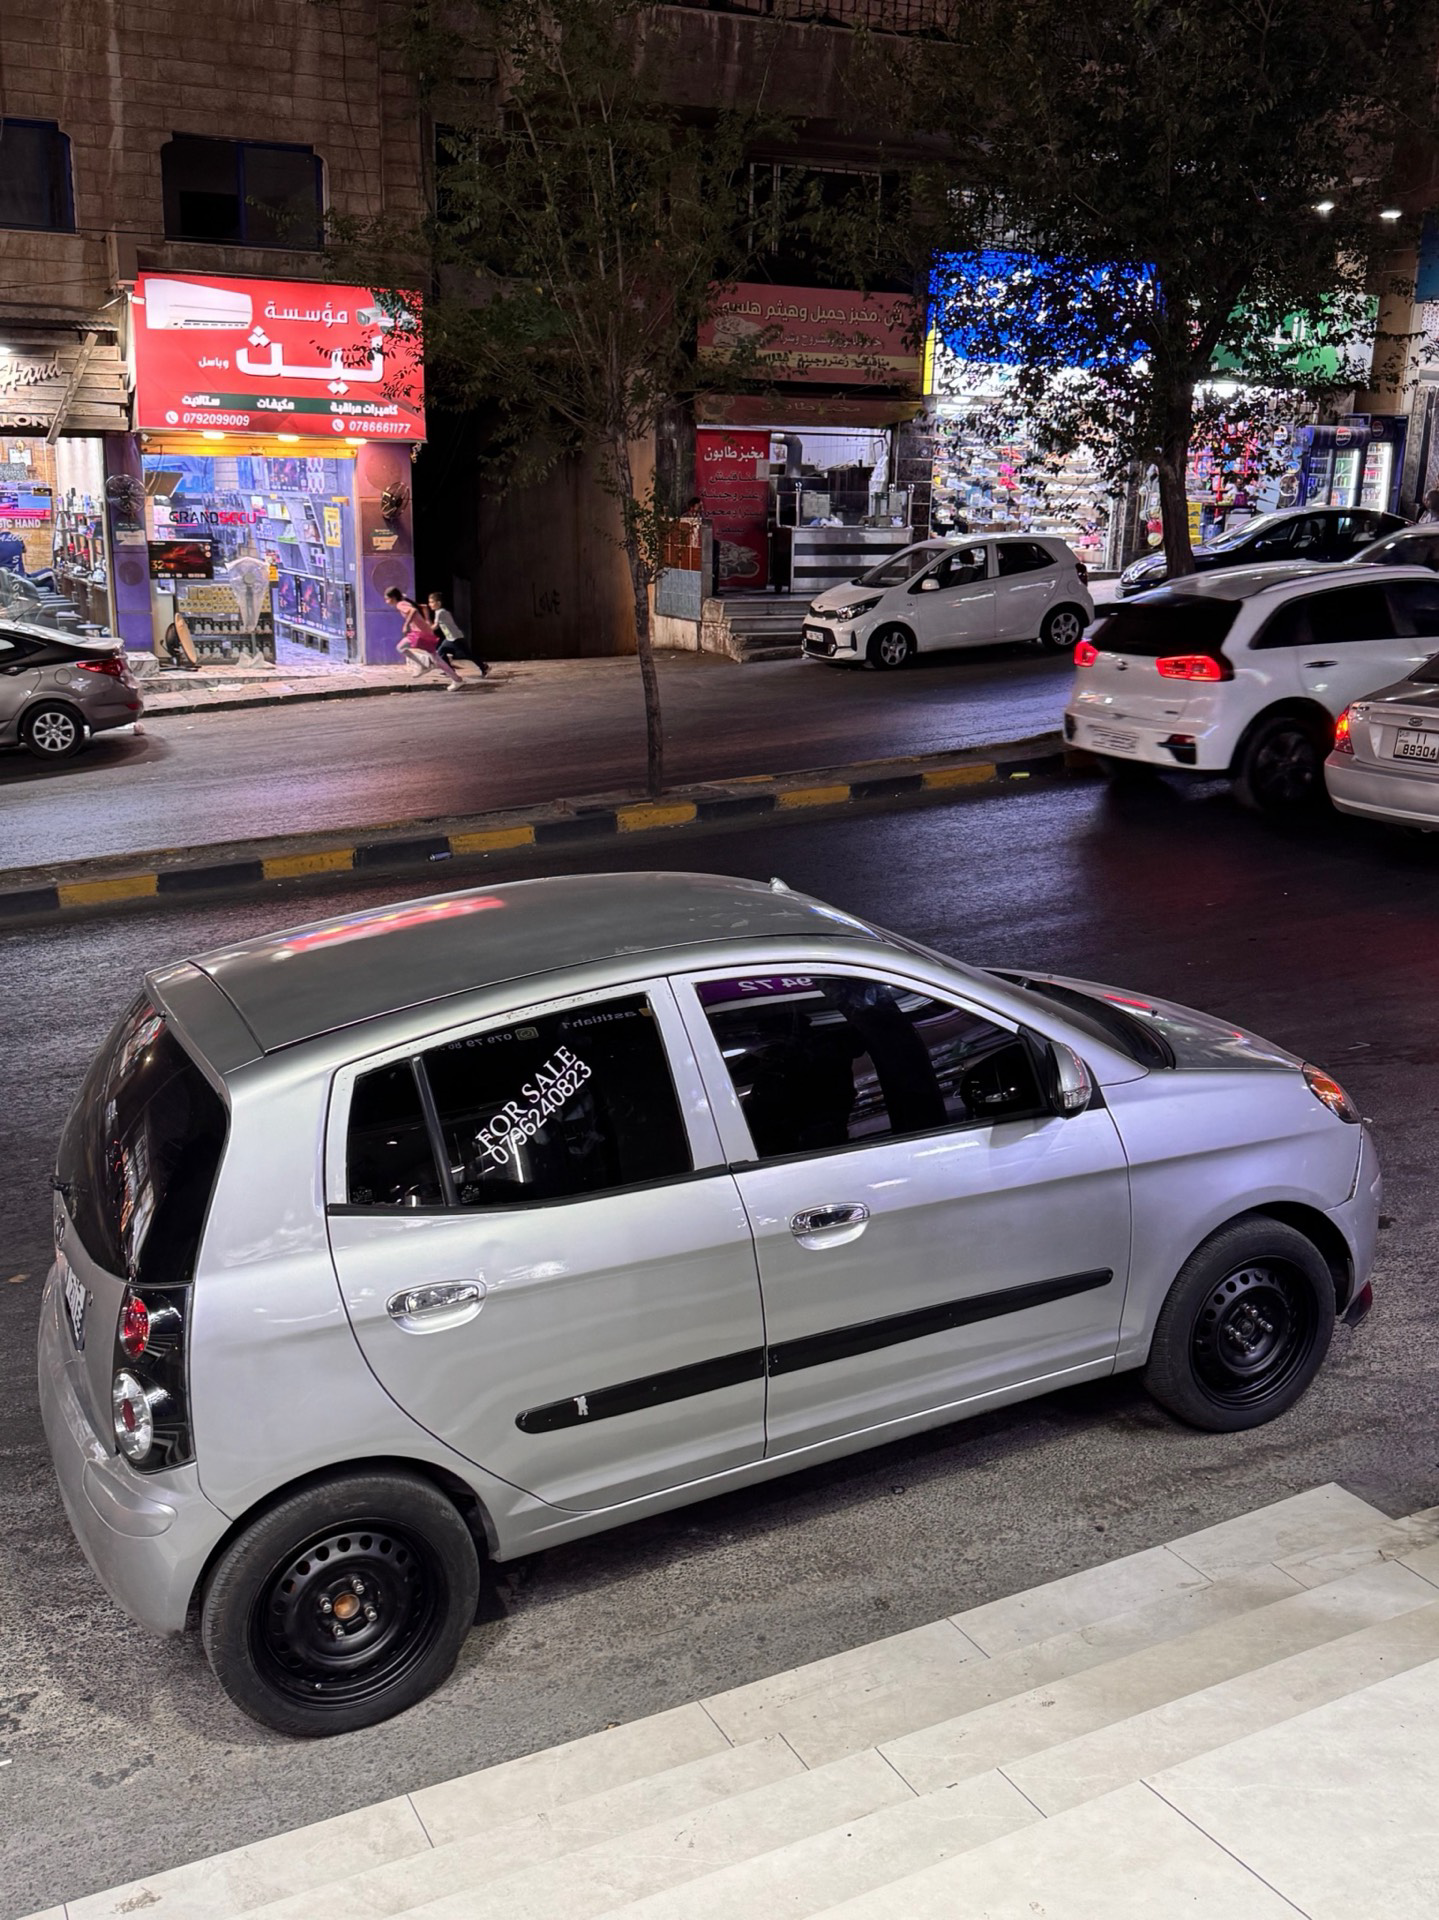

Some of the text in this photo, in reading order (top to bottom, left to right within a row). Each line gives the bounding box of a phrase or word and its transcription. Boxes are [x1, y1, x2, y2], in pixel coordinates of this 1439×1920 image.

[264, 301, 348, 327] مؤسسة
[764, 300, 808, 322] وهيثم
[810, 307, 846, 323] جميل
[198, 357, 229, 369] وباسل
[236, 326, 383, 395] ليث
[256, 398, 295, 412] مكيفات
[330, 402, 361, 415] مراقبة
[363, 404, 398, 416] كاميرات
[183, 412, 250, 426] 0792099009
[350, 422, 411, 434] 0786661177
[704, 446, 764, 462] مخبز طابون
[15, 519, 41, 528] HAND
[1402, 744, 1436, 758] 89304
[475, 1045, 577, 1153] FOR SALE
[490, 1060, 592, 1165] 0796240823
